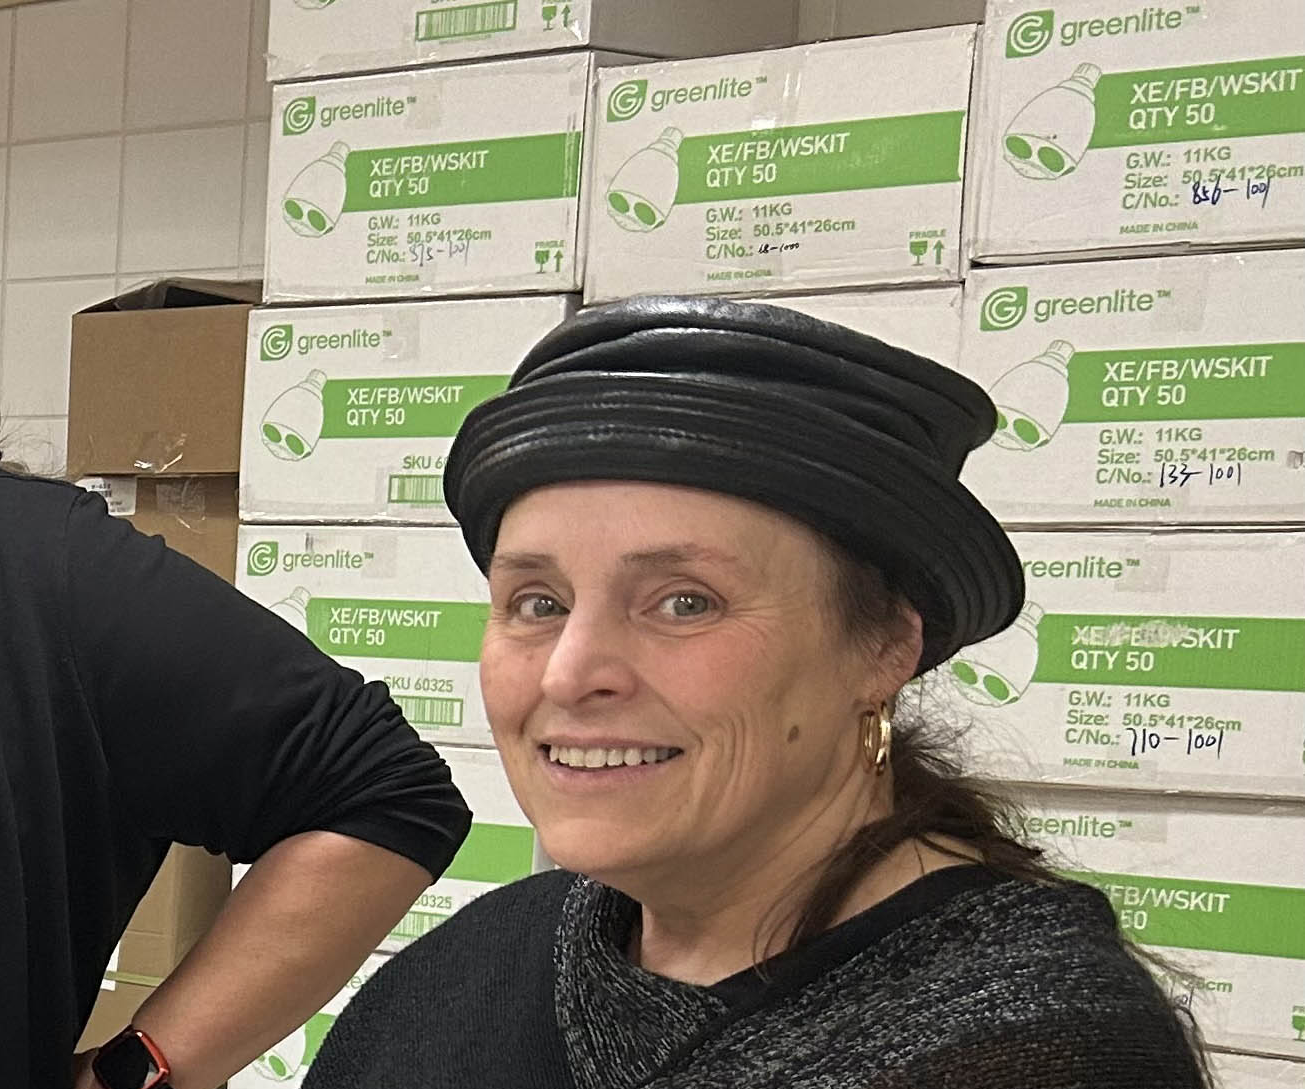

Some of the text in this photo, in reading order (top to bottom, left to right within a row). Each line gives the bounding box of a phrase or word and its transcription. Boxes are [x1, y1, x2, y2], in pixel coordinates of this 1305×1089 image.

[1130, 69, 1303, 104] XE/FB/WSKIT
[1129, 104, 1214, 129] QTY 50
[707, 132, 850, 164] XE/FB/WSKIT
[1183, 146, 1231, 164] 11KG
[370, 150, 489, 177] XE/FB/WSKIT
[706, 163, 776, 188] QTY 50
[1123, 172, 1168, 190] Size:
[369, 176, 429, 198] QTY 50
[407, 213, 441, 226] 11KG
[752, 204, 791, 218] 11KG
[705, 224, 742, 242] Size:
[1119, 221, 1198, 234] MADE CHINA
[367, 231, 398, 247] Size:
[1103, 355, 1273, 383] XE/FB/WSKIT
[346, 385, 464, 406] XE/FB/WSKIT
[1102, 385, 1186, 407] QTY 50
[346, 408, 405, 426] QTY 50
[1155, 428, 1202, 442] 11KG
[402, 456, 432, 469] SKU
[1097, 449, 1140, 465] Size:
[1093, 498, 1125, 508] MADE
[329, 607, 441, 628] XE/FB/WSKIT
[329, 628, 385, 645] QTY 50
[1071, 651, 1154, 671] QTY 50
[414, 677, 453, 692] 60325
[1125, 694, 1171, 707] 11KG
[1067, 710, 1109, 726] Size:
[1063, 758, 1139, 769] MADE CHINA
[1120, 910, 1148, 930] 50
